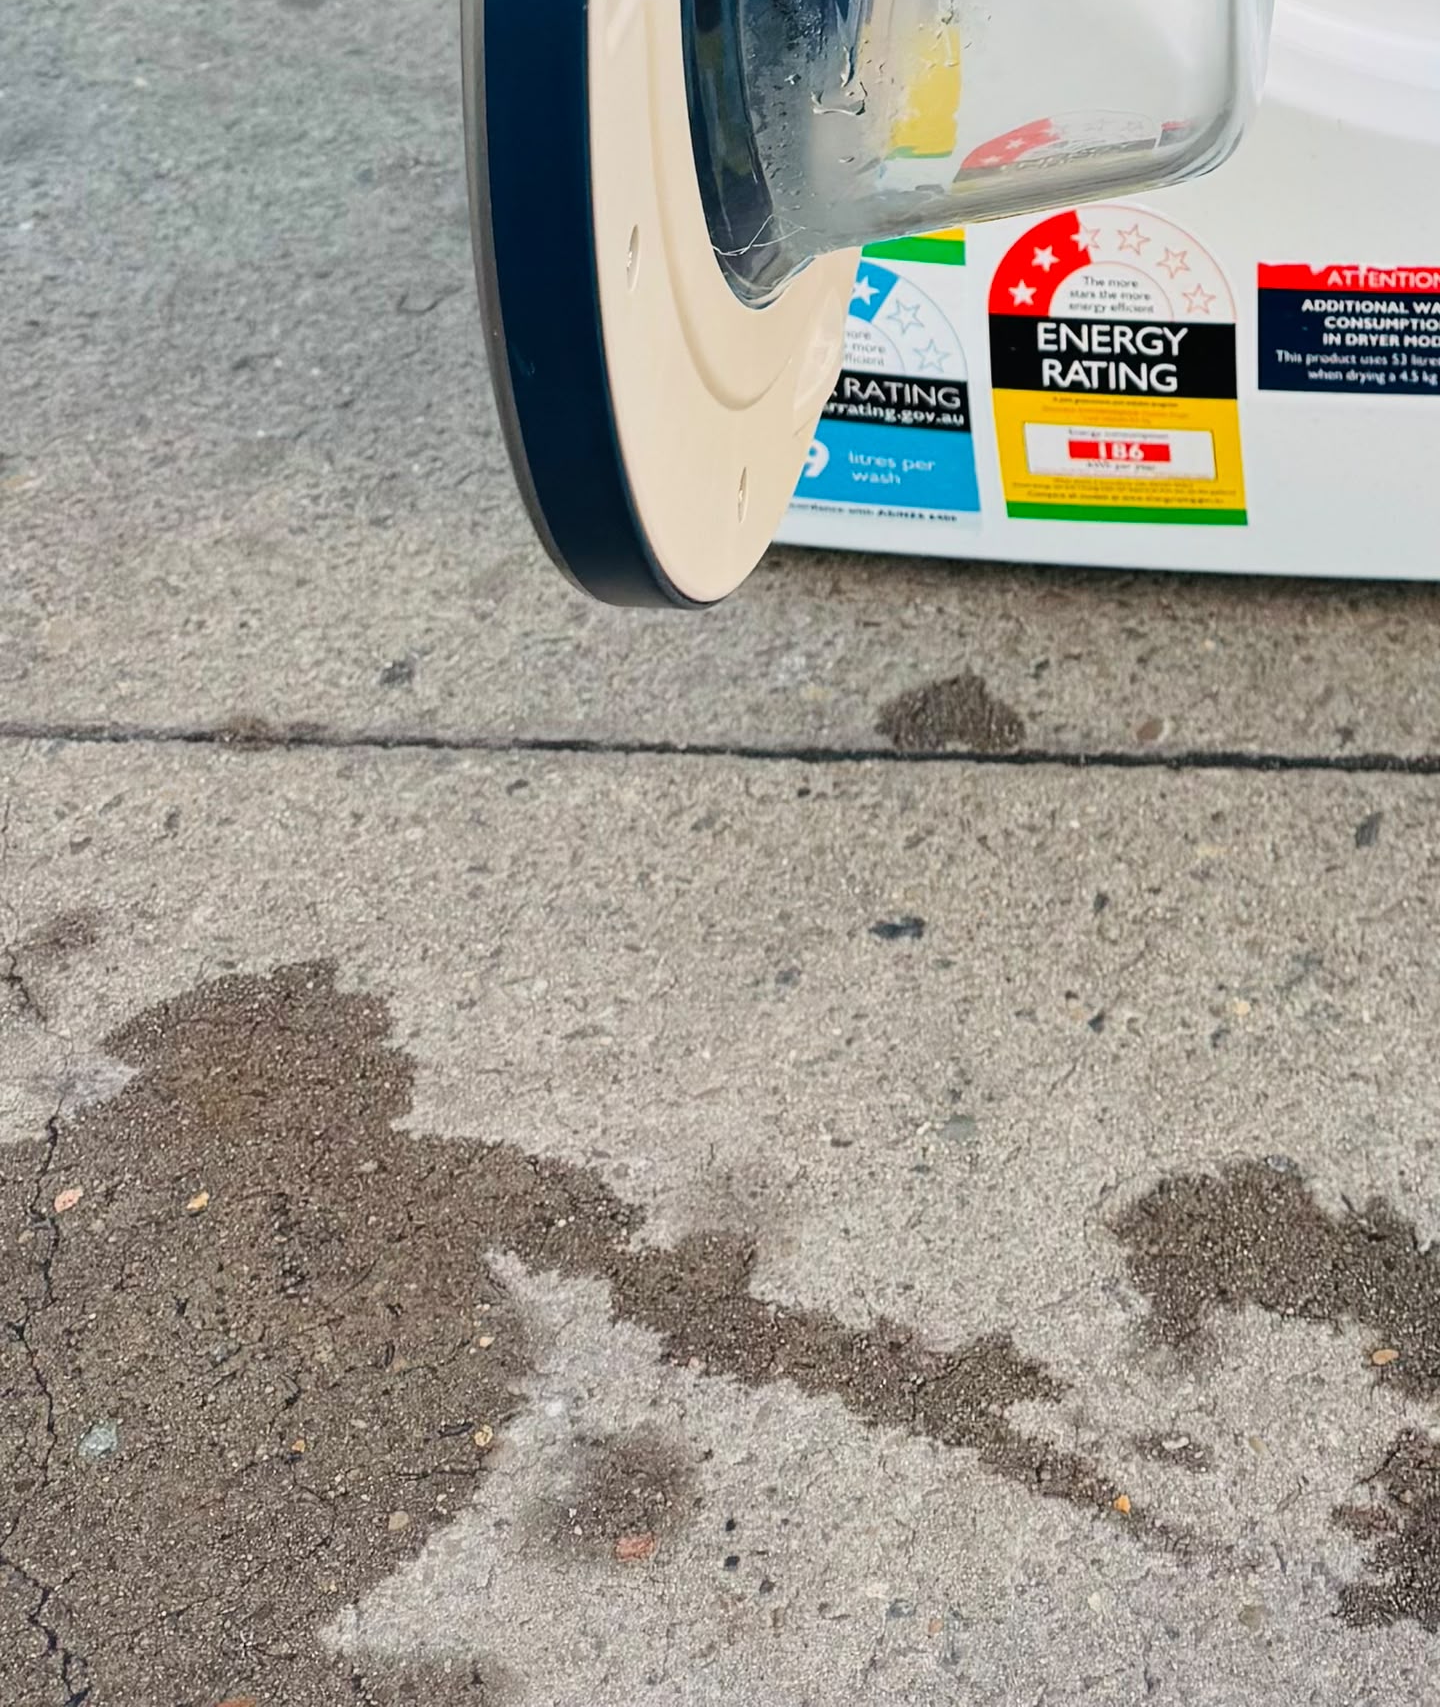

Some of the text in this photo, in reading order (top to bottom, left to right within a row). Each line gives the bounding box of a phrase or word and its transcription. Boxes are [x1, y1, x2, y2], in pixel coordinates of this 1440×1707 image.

[1083, 275, 1138, 288] The more
[1099, 289, 1117, 300] the
[1120, 292, 1151, 301] more
[1069, 302, 1106, 314] energy
[1302, 298, 1409, 314] ADDITIONAL
[1037, 322, 1188, 356] ENERGY
[1323, 332, 1341, 346] IN
[1345, 333, 1400, 348] DRYER
[1276, 349, 1302, 364] This
[1305, 351, 1357, 366] product
[1360, 355, 1388, 366] uses
[1041, 358, 1178, 393] RATING
[1308, 368, 1343, 381] when
[1346, 369, 1386, 386] drying
[1389, 373, 1396, 383] a
[1400, 371, 1419, 383] 4.5
[1422, 371, 1438, 386] kg
[844, 377, 961, 409] RATING
[1098, 441, 1145, 461] 186
[848, 451, 936, 472] litres per
[852, 471, 901, 484] wash
